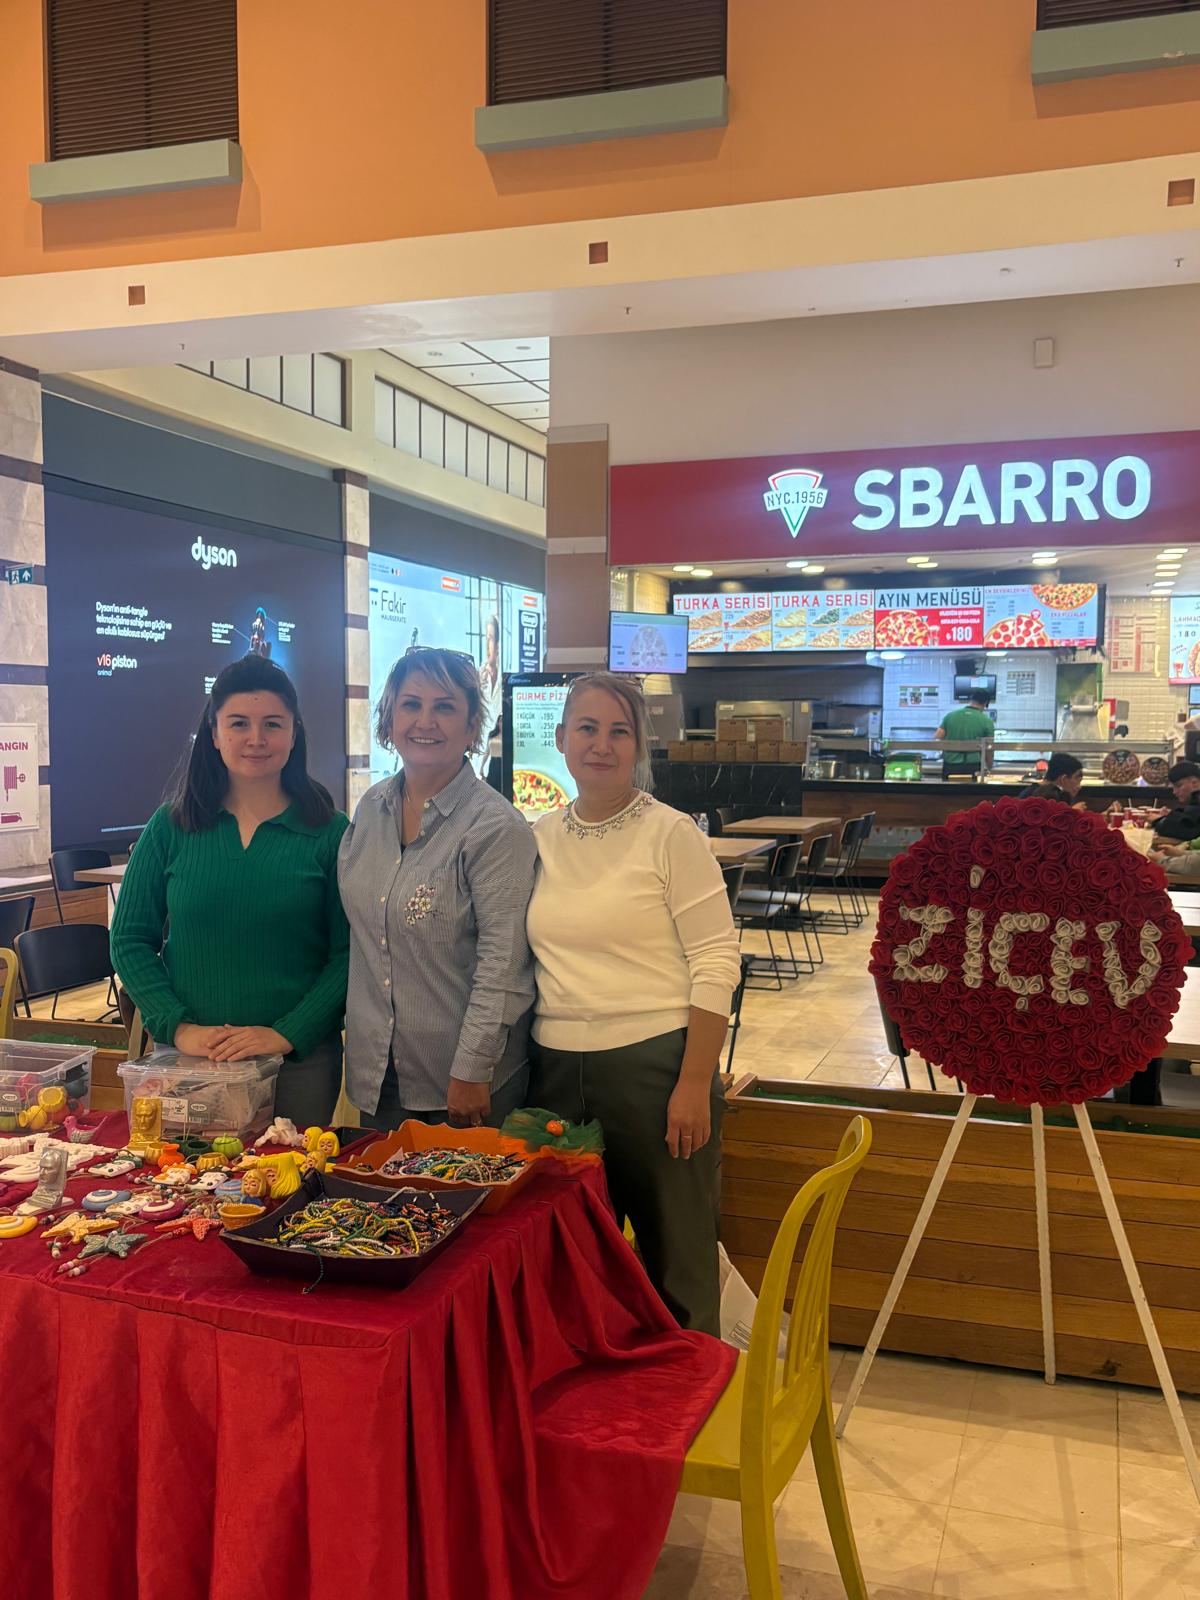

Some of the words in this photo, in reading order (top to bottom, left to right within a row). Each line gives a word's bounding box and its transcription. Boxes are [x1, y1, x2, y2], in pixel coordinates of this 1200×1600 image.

[766, 490, 823, 507] NYC.1956
[852, 455, 1151, 531] SBARRO
[191, 535, 238, 570] dyson
[381, 590, 406, 614] Fakir
[675, 598, 719, 610] TURKA
[724, 593, 770, 609] SERİSİ
[773, 595, 820, 608] TURKA
[826, 591, 873, 606] SERİSİ
[878, 593, 910, 608] AYIN
[916, 587, 981, 607] MENÜSÜ
[97, 653, 112, 667] v16
[111, 655, 138, 670] piston
[516, 692, 547, 701] GURME
[891, 864, 1162, 1011] ZİÇEV
